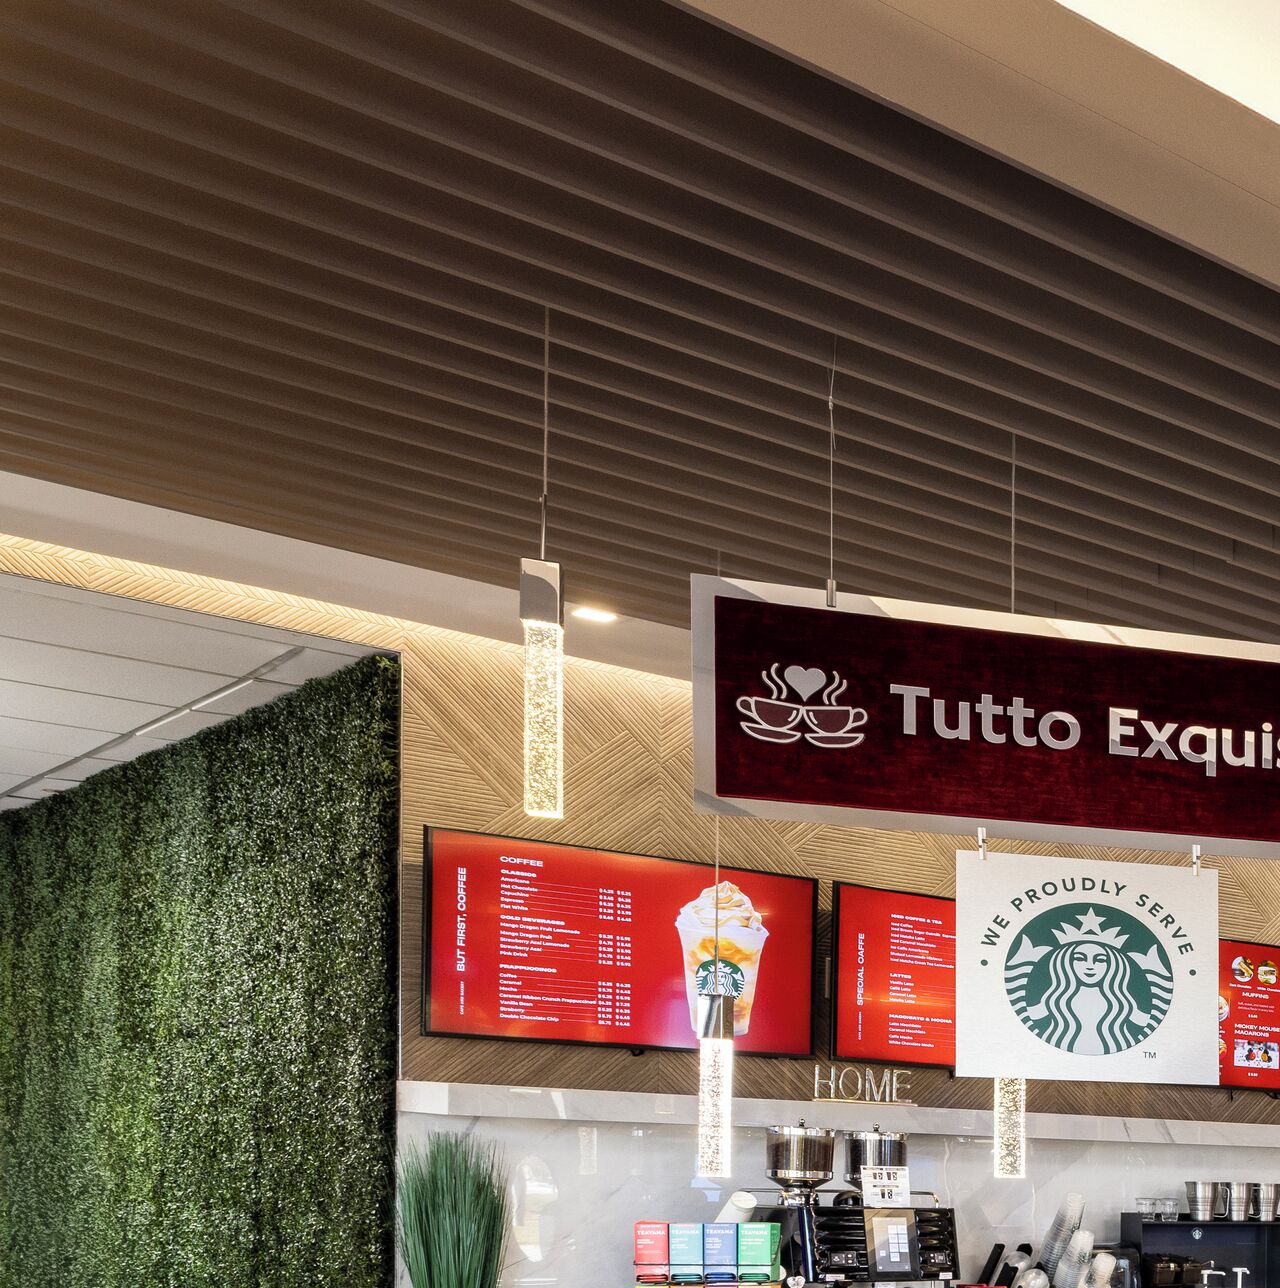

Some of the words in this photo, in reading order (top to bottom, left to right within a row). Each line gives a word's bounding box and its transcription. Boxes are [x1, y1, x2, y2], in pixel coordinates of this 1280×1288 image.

[890, 683, 1081, 750] Tutto
[500, 856, 544, 867] COFFEE
[501, 869, 537, 878] CLASSICS
[457, 867, 467, 911] COFFEE
[522, 916, 565, 926] BEVERAGES
[981, 914, 1011, 948] WE
[1010, 877, 1128, 913] PROUDLY
[1135, 893, 1194, 955] SERVE
[457, 914, 467, 946] FIRST,
[553, 927, 580, 935] Lemonade
[500, 943, 529, 952] Strawberry
[457, 949, 466, 972] BUT
[499, 963, 557, 973] FRAPPUCCINOS
[856, 967, 864, 1006] SPECIAL
[1242, 991, 1270, 1000] MUFFINS
[1234, 1023, 1258, 1031] MICKEY
[1259, 1024, 1280, 1032] MOUSE
[1234, 1029, 1269, 1038] MACARONS
[814, 1064, 912, 1103] HOME
